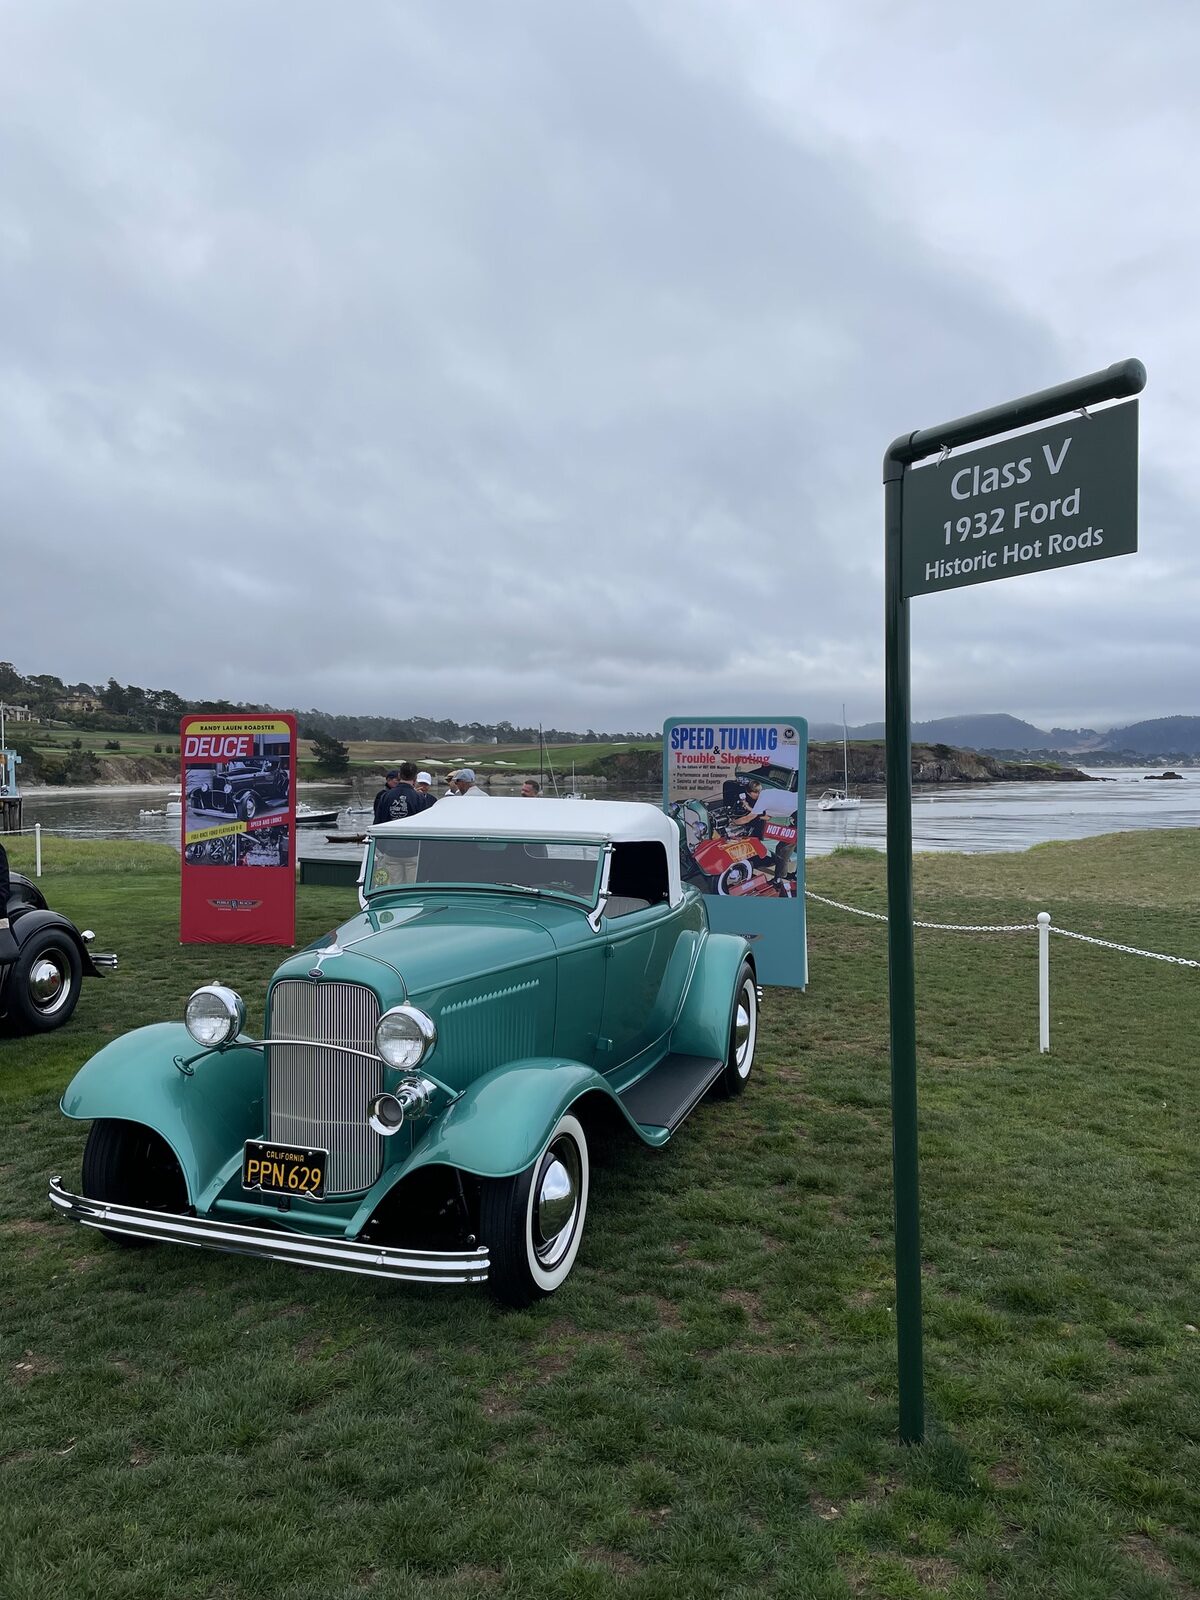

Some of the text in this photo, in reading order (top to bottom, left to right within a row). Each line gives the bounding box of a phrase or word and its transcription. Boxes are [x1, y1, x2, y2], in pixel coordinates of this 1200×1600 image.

[951, 437, 1072, 501] Class V
[943, 488, 1081, 546] 1932 Ford
[925, 527, 1104, 581] Historic Hot Rods
[184, 736, 249, 757] DEUCE
[671, 727, 778, 751] SPEED TUNING
[675, 752, 770, 767] Trouble Shooting
[713, 746, 720, 755] &
[766, 824, 796, 838] HOT ROD
[266, 1150, 305, 1162] CALIFORNIA
[247, 1159, 322, 1191] PPN 629
